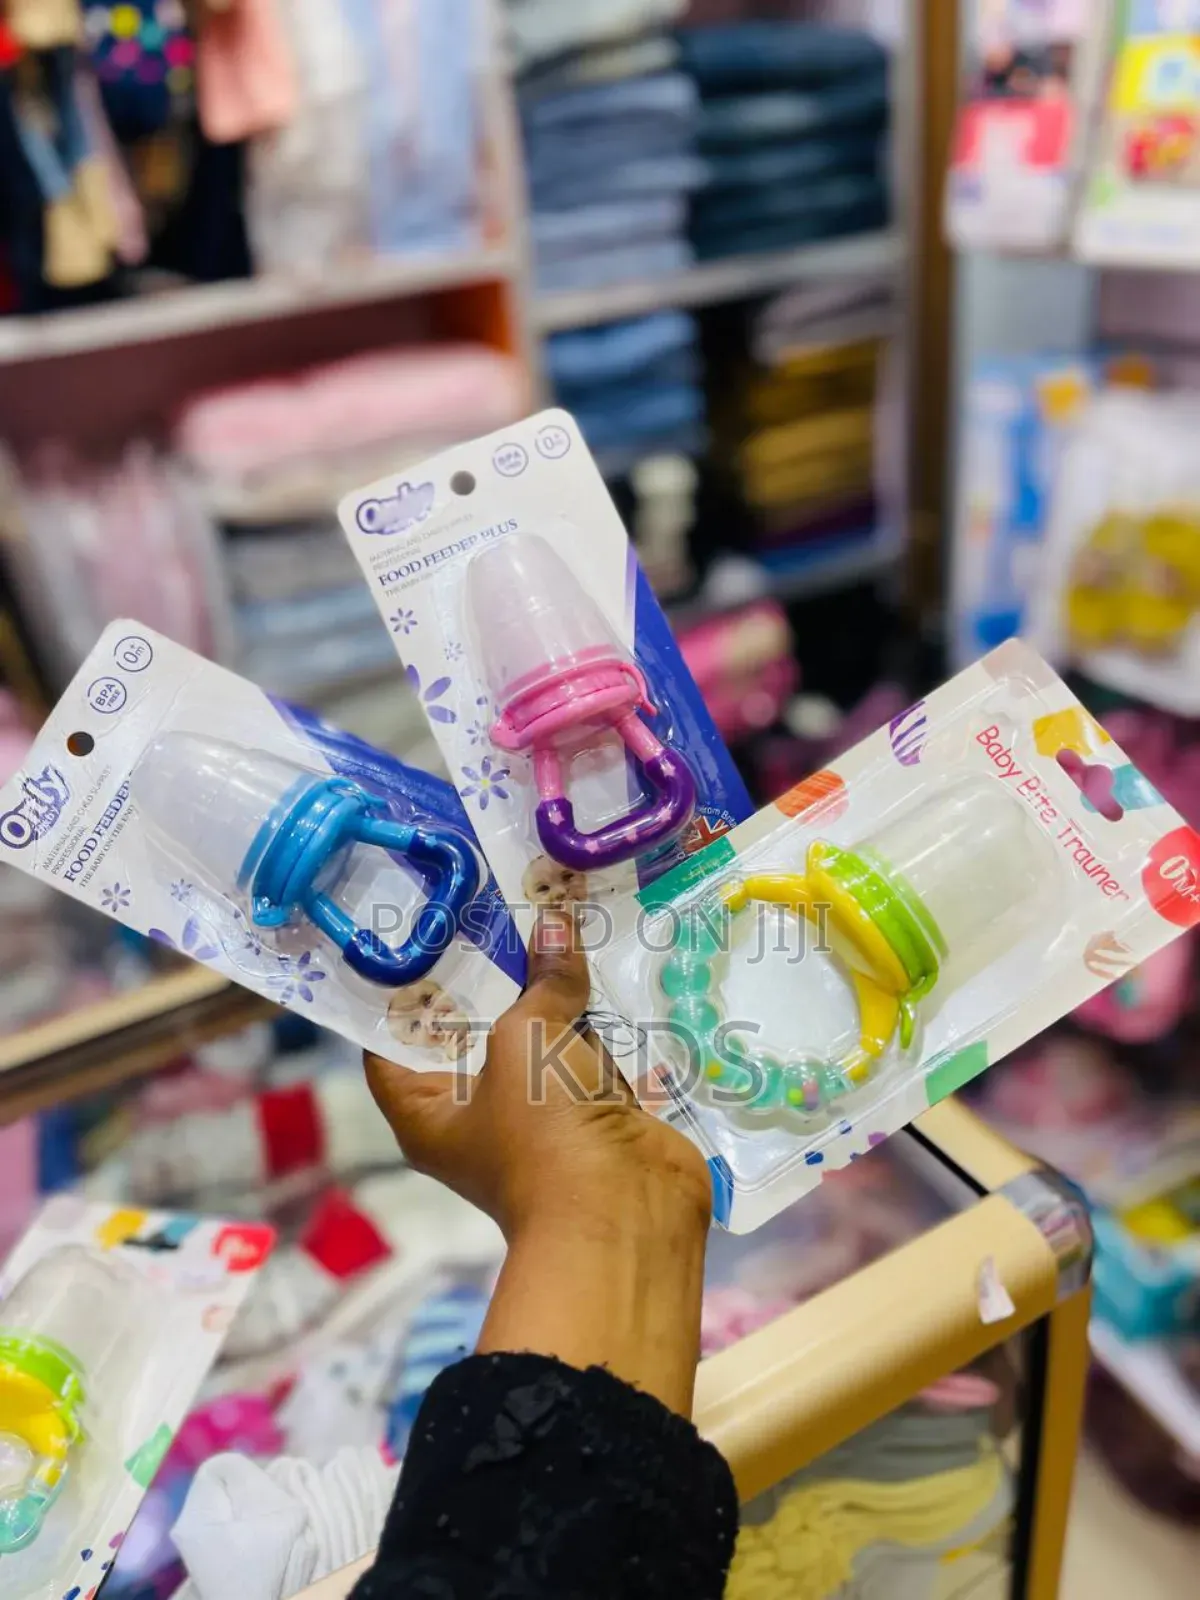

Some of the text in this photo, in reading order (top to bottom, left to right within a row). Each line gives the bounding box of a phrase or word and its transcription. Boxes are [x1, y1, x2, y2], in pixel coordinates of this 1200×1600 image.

[378, 560, 421, 586] FOOD
[481, 518, 518, 541] PLUS
[95, 683, 115, 706] BPA
[975, 724, 1022, 779] Baby
[64, 837, 98, 882] FOOD
[78, 871, 92, 887] THE
[101, 837, 114, 852] ON
[110, 822, 124, 838] THE
